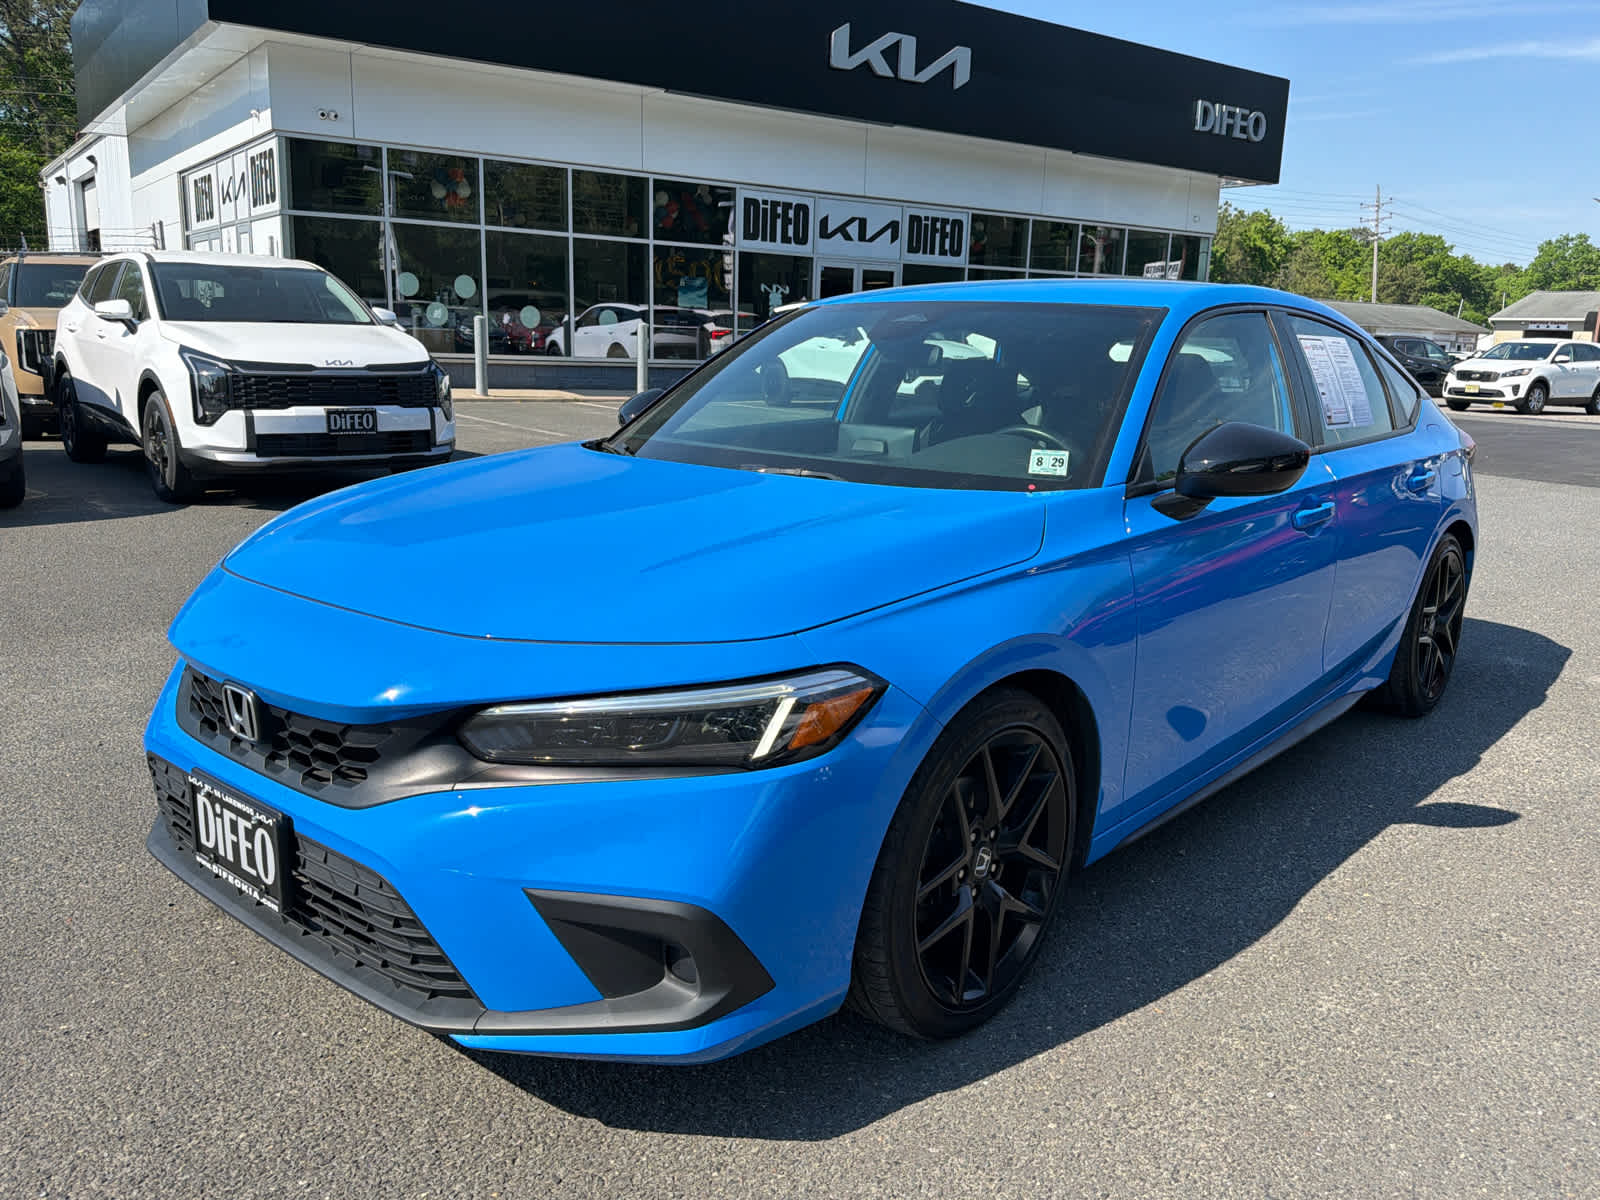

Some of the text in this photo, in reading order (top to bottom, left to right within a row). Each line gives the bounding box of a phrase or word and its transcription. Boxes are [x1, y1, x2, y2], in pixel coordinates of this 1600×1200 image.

[829, 21, 972, 91] KIA
[1194, 99, 1267, 142] DIFEO
[193, 173, 215, 223] DiFEO
[249, 147, 277, 208] DiFEO
[743, 197, 810, 246] DiFEO
[906, 214, 964, 258] DiFEO
[329, 412, 374, 431] DiFEO
[1035, 456, 1065, 468] 8 29
[195, 793, 277, 886] DiFEO
